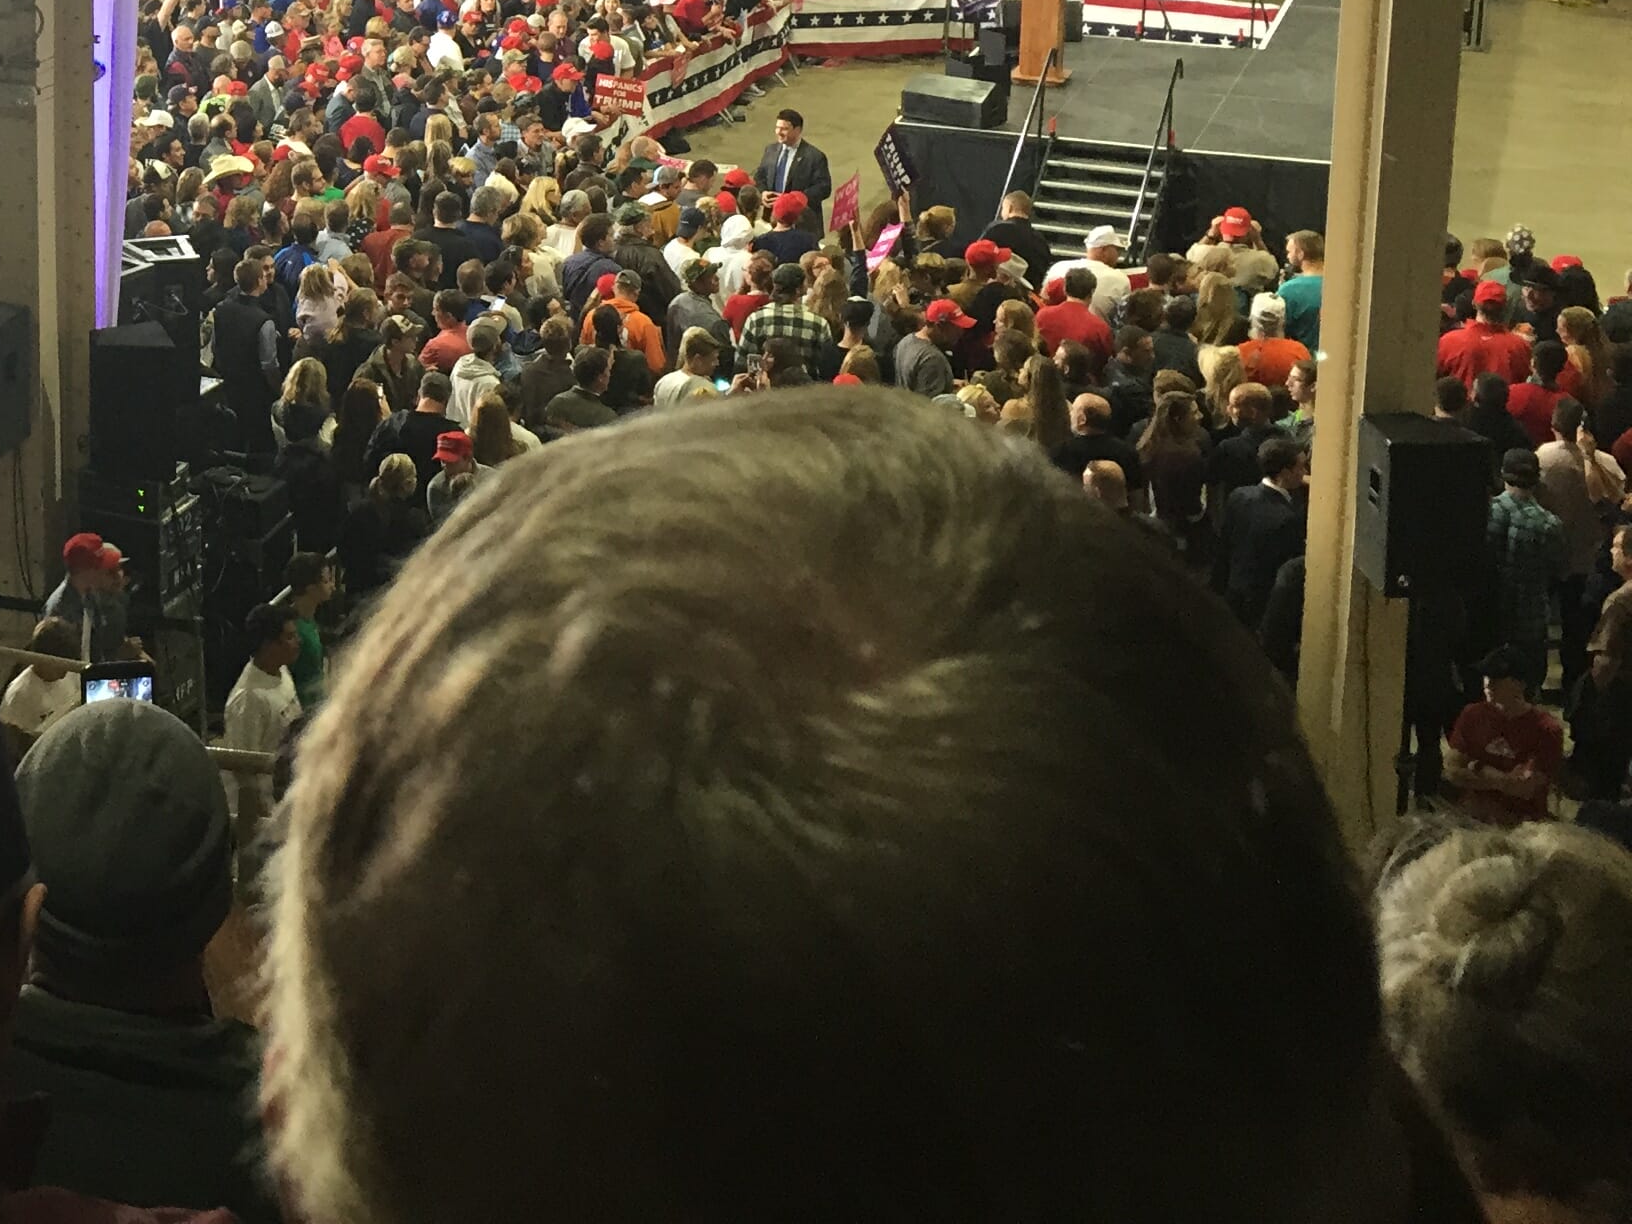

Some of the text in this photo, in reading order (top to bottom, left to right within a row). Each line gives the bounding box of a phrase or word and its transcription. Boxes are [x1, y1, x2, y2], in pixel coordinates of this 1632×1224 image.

[598, 78, 643, 93] HISPANICS
[612, 89, 627, 98] FOR
[594, 94, 642, 110] TRUMP
[886, 133, 912, 186] TRUMP
